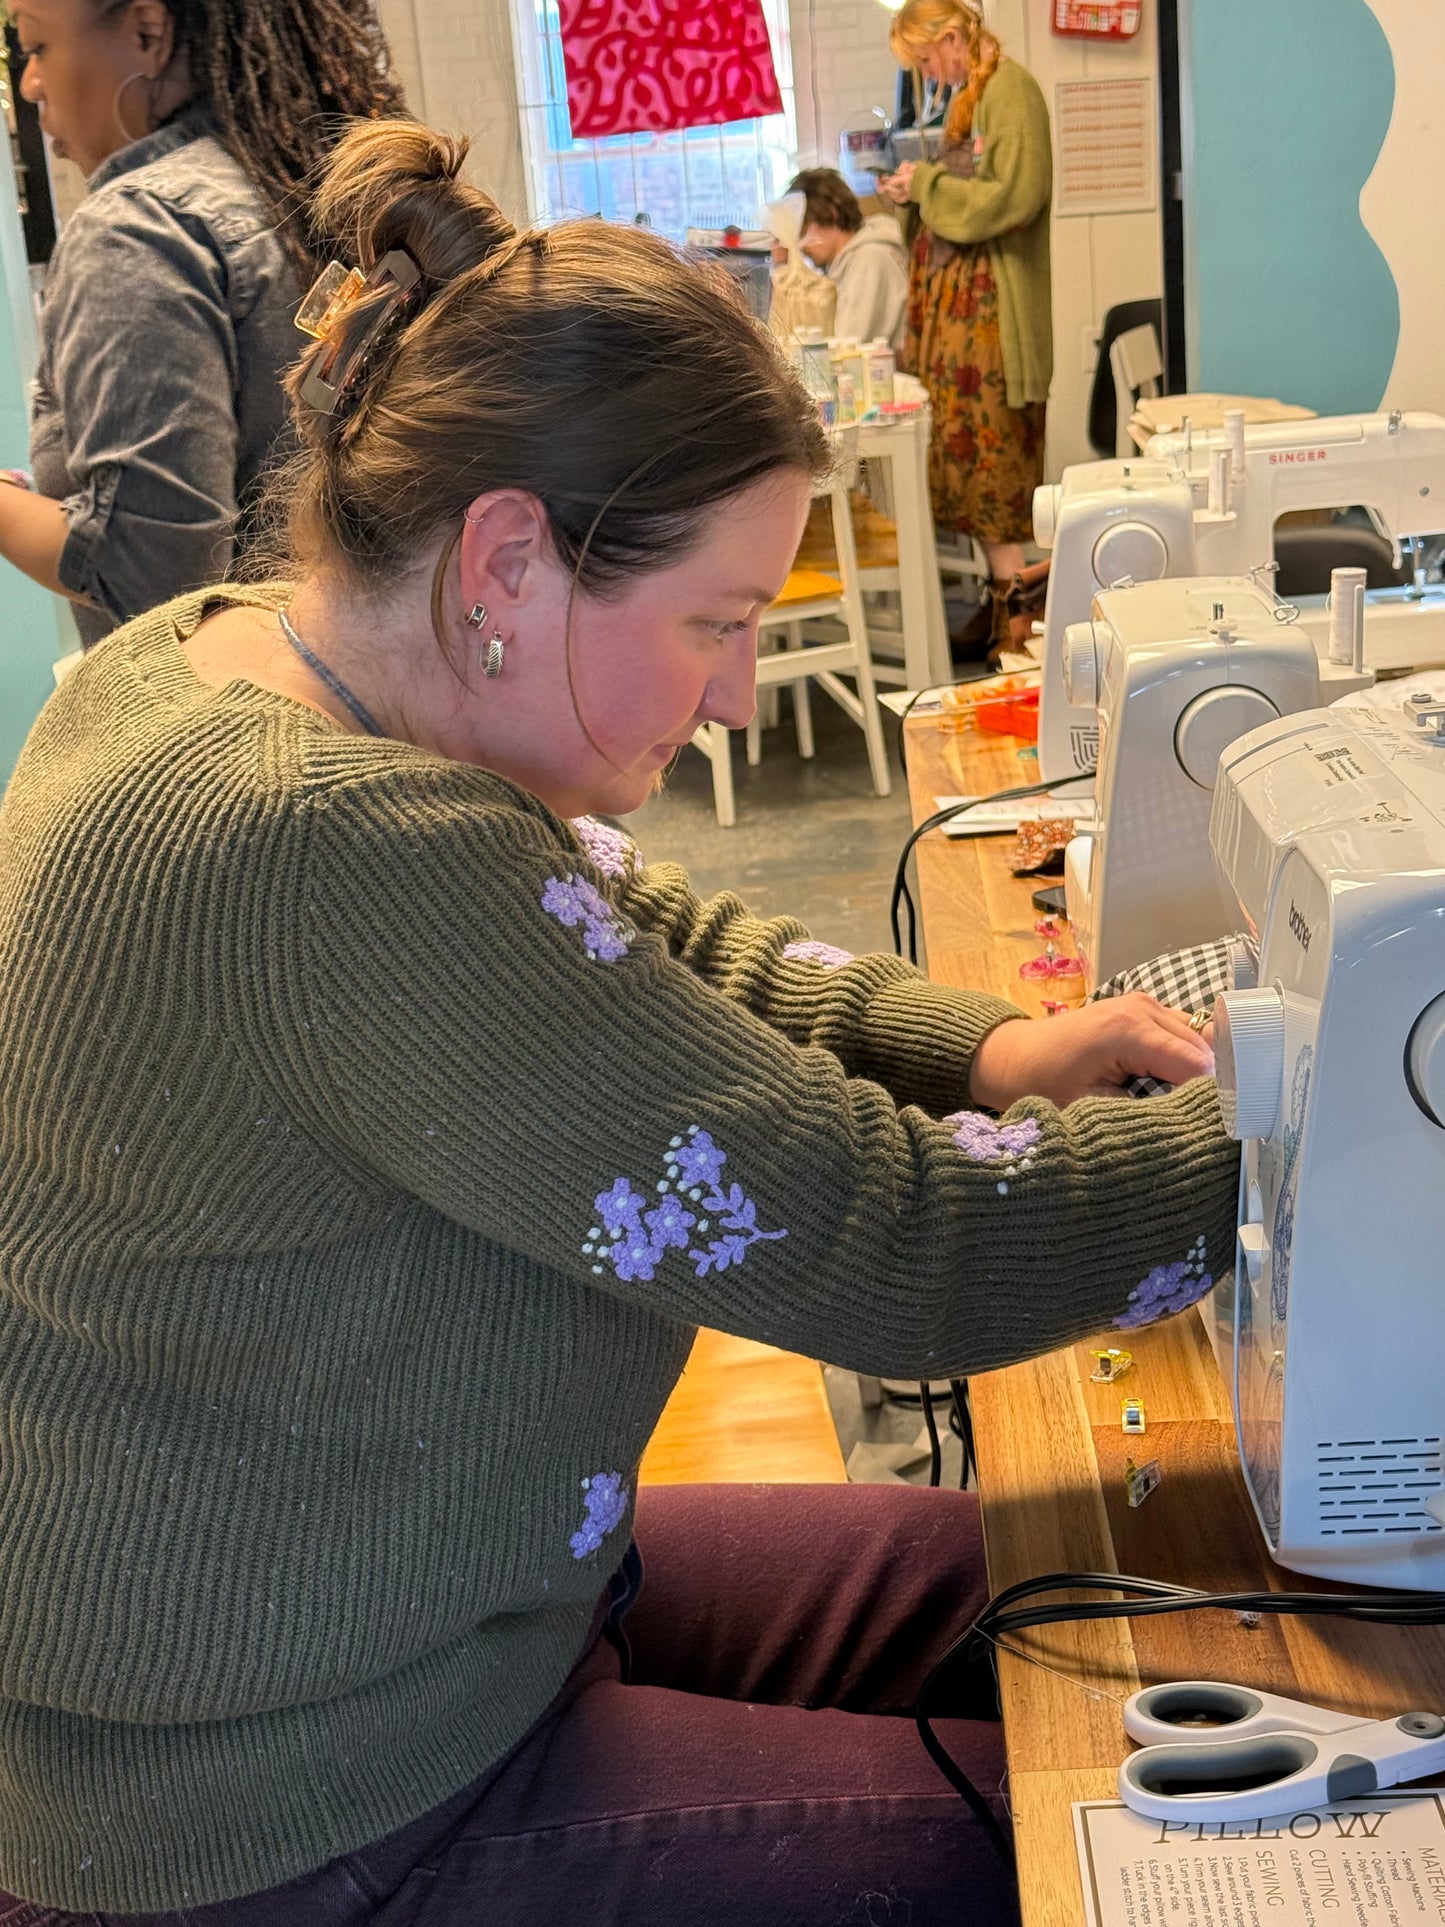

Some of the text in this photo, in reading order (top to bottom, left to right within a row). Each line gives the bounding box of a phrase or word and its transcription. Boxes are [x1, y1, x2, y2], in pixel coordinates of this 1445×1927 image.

[1269, 450, 1327, 464] SINGER
[1289, 898, 1311, 952] brother
[1289, 1849, 1299, 1861] Cut
[1119, 1866, 1130, 1886] ladder
[1164, 1864, 1173, 1873] on
[1291, 1867, 1306, 1888] pieces
[1342, 1859, 1355, 1876] Hand
[1387, 1859, 1402, 1881] Thread
[1166, 1874, 1175, 1885] the
[1180, 1880, 1192, 1895] your
[1212, 1879, 1222, 1891] sew
[1255, 1850, 1284, 1906] SEWING
[1309, 1849, 1340, 1908] CUTTING
[1371, 1858, 1387, 1884] Quilting
[1381, 1885, 1394, 1908] Cotton
[1402, 1858, 1426, 1911] Sewing Machine
[1123, 1888, 1133, 1906] stitch
[1139, 1891, 1149, 1902] the
[1150, 1881, 1162, 1896] your
[1195, 1879, 1207, 1894] your
[1201, 1895, 1210, 1913] seam
[1215, 1893, 1224, 1904] the
[1227, 1877, 1241, 1900] around
[1240, 1874, 1251, 1889] your
[1246, 1890, 1256, 1909] fabric
[1347, 1878, 1361, 1902] Sewing
[1363, 1881, 1378, 1908] Stuffing
[1141, 1904, 1152, 1925] edges
[1153, 1897, 1166, 1917] pillow
[1184, 1897, 1197, 1915] piece
[1218, 1906, 1227, 1917] last
[1302, 1897, 1313, 1916] fabric
